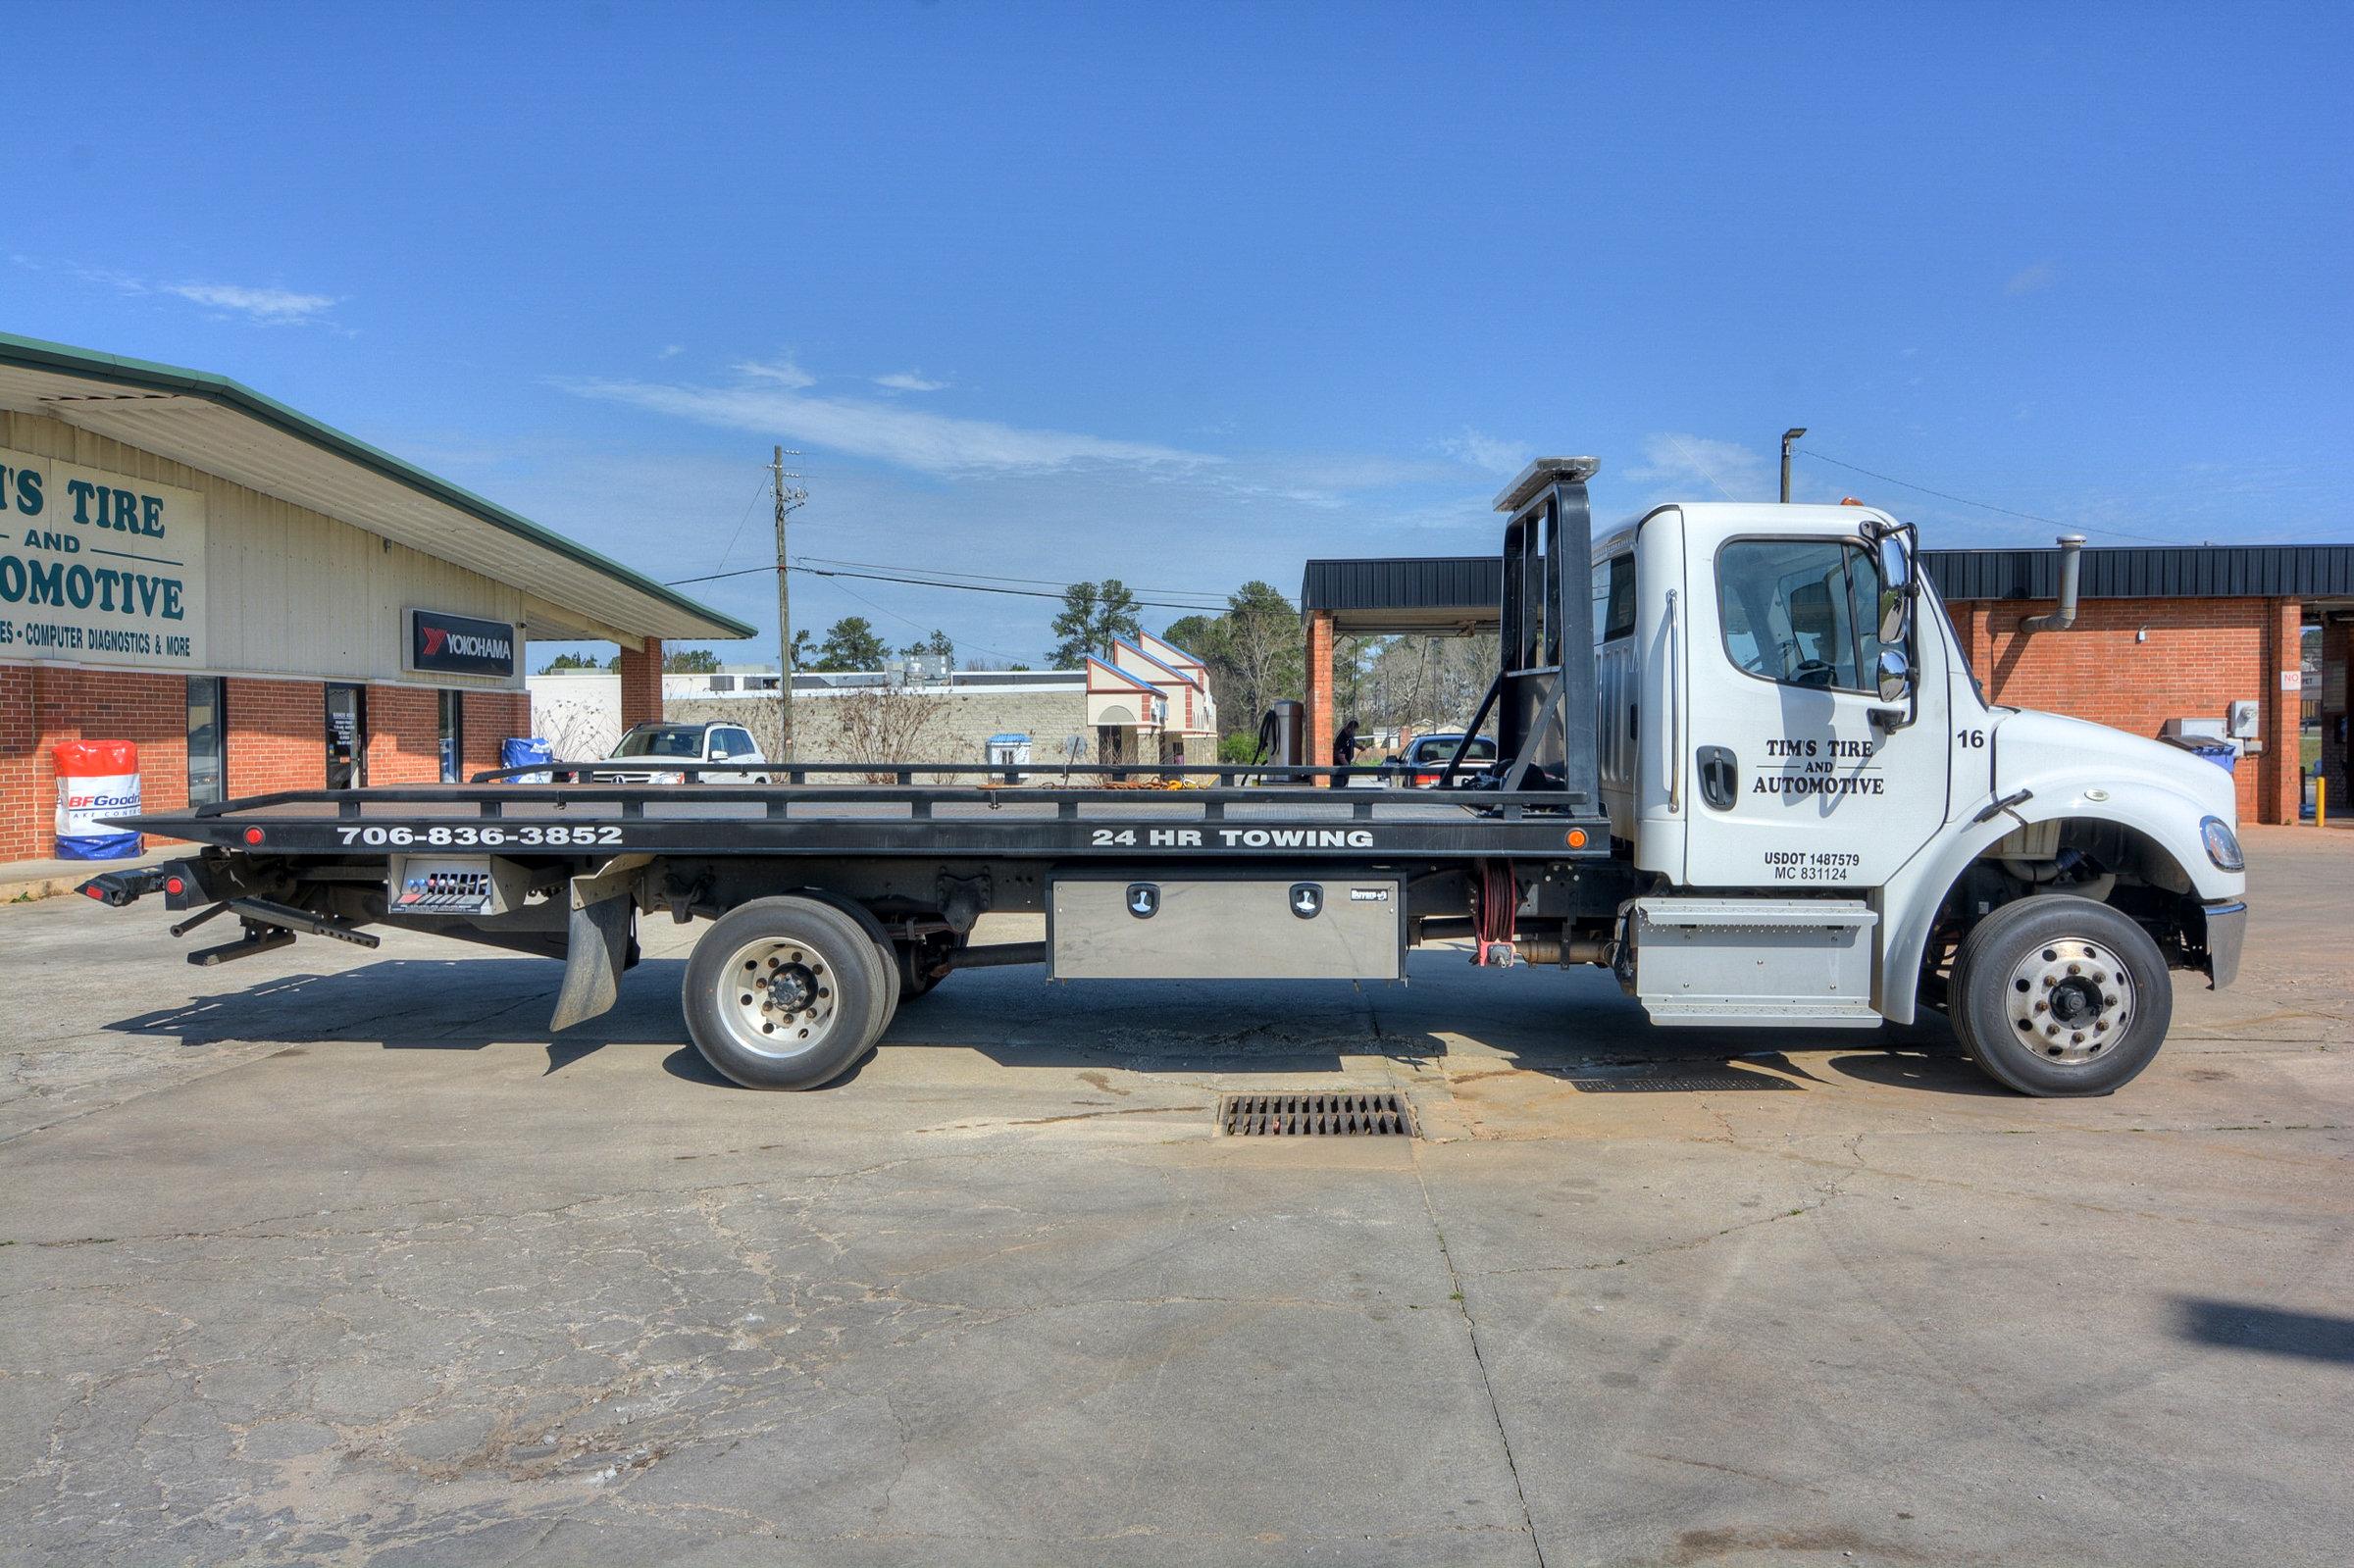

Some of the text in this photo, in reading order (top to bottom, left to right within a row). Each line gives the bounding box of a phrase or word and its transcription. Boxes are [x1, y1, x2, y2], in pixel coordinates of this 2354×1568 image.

[67, 479, 165, 539] TIRE
[24, 529, 80, 554] AND
[0, 555, 184, 621] OMOTIVE
[26, 622, 82, 650] COMPUTER
[88, 629, 150, 655] DIAGNOSTICS
[155, 634, 162, 655] &
[166, 636, 190, 657] MORE
[446, 633, 511, 660] YOKOHAMA
[2284, 674, 2299, 683] NO
[1766, 739, 1873, 757] TIM'S TIRE
[1957, 730, 1984, 748] 16
[1805, 762, 1833, 773] AND
[1753, 777, 1884, 794] AUTOMOTIVE
[336, 826, 623, 846] 706-836-3852
[1092, 830, 1373, 847] 24 HR TOWING
[1765, 852, 1860, 866] USDOT 1487579
[1774, 867, 1847, 881] MC 831124
